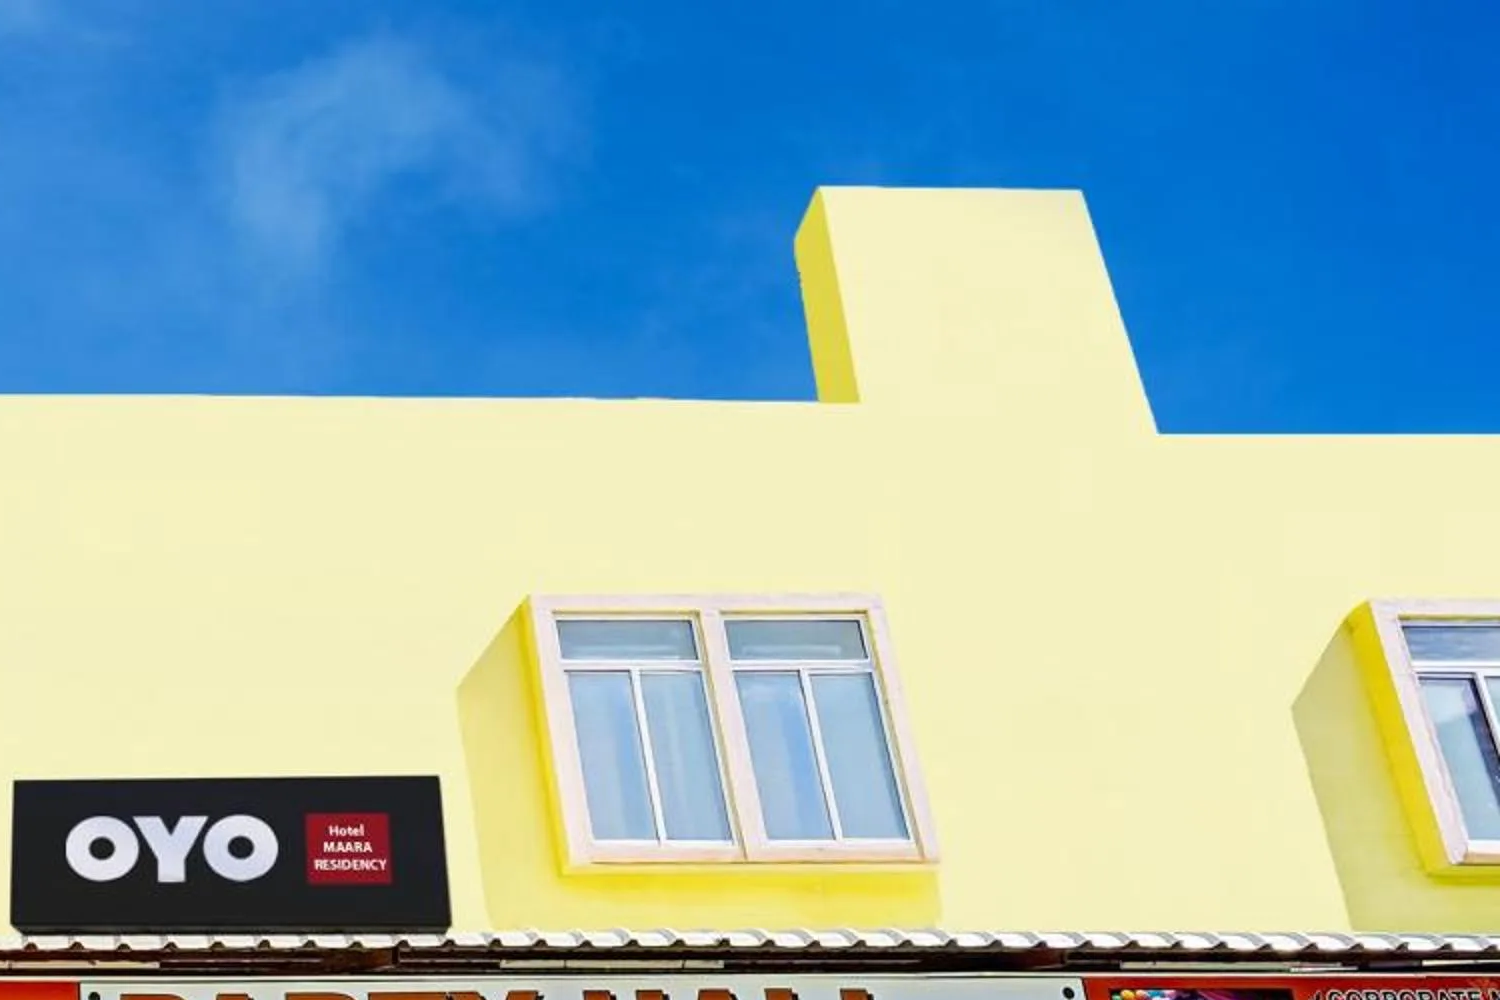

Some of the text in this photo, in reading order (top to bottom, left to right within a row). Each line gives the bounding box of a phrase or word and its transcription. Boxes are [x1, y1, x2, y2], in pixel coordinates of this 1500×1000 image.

[328, 823, 365, 837] Hotel
[66, 814, 279, 883] OYO
[323, 840, 373, 853] MAARA
[314, 858, 387, 872] RESIDENCY
